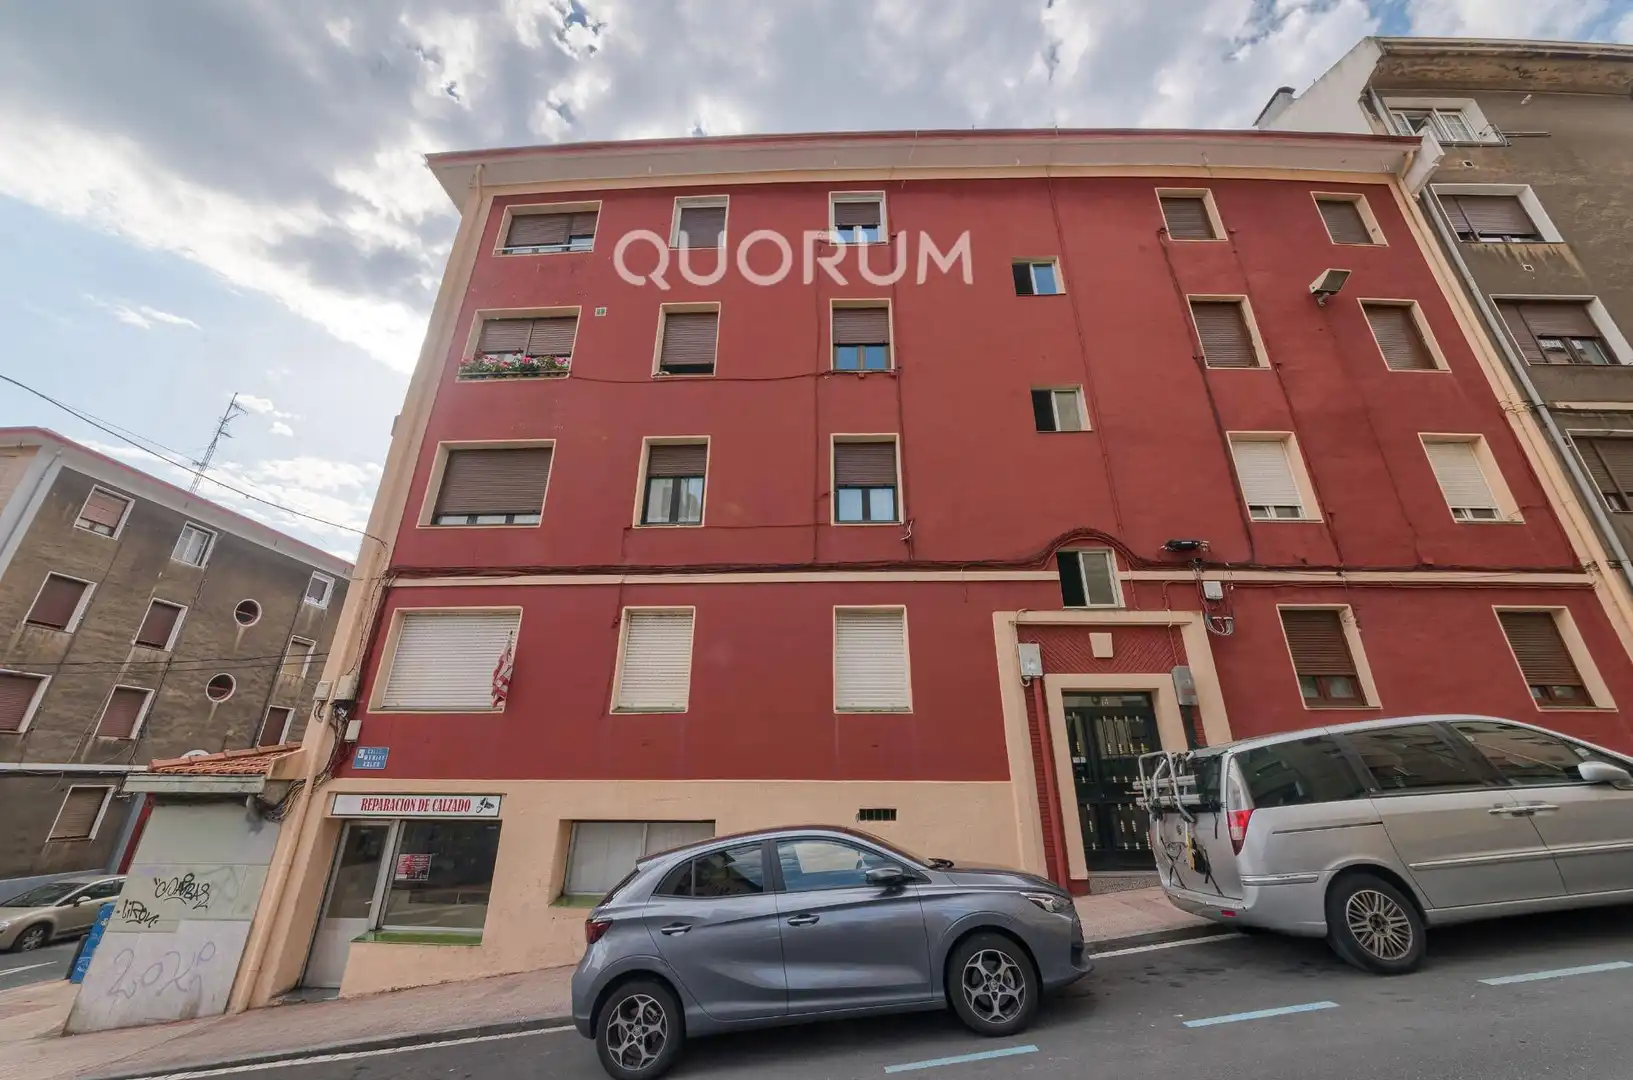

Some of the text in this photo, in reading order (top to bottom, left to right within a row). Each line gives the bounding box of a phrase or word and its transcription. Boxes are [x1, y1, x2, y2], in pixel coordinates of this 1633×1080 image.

[360, 797, 471, 813] REPARACION DE CALZADO
